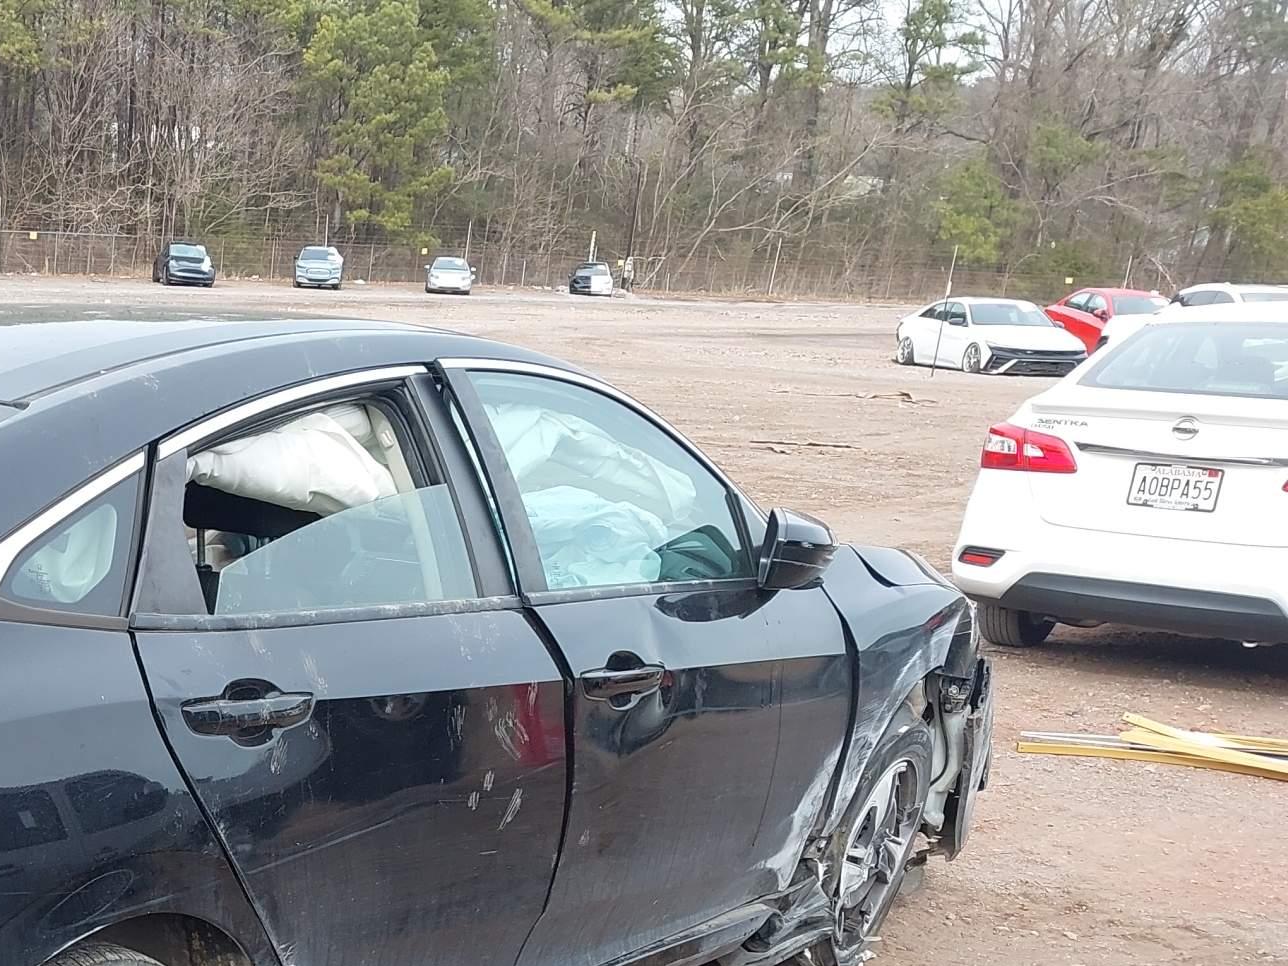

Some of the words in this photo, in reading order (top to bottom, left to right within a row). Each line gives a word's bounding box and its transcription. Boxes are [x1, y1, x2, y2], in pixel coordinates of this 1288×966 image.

[1037, 418, 1088, 427] SENTRA
[1155, 467, 1202, 478] ALABAMA
[1136, 475, 1215, 501] A0BPA55
